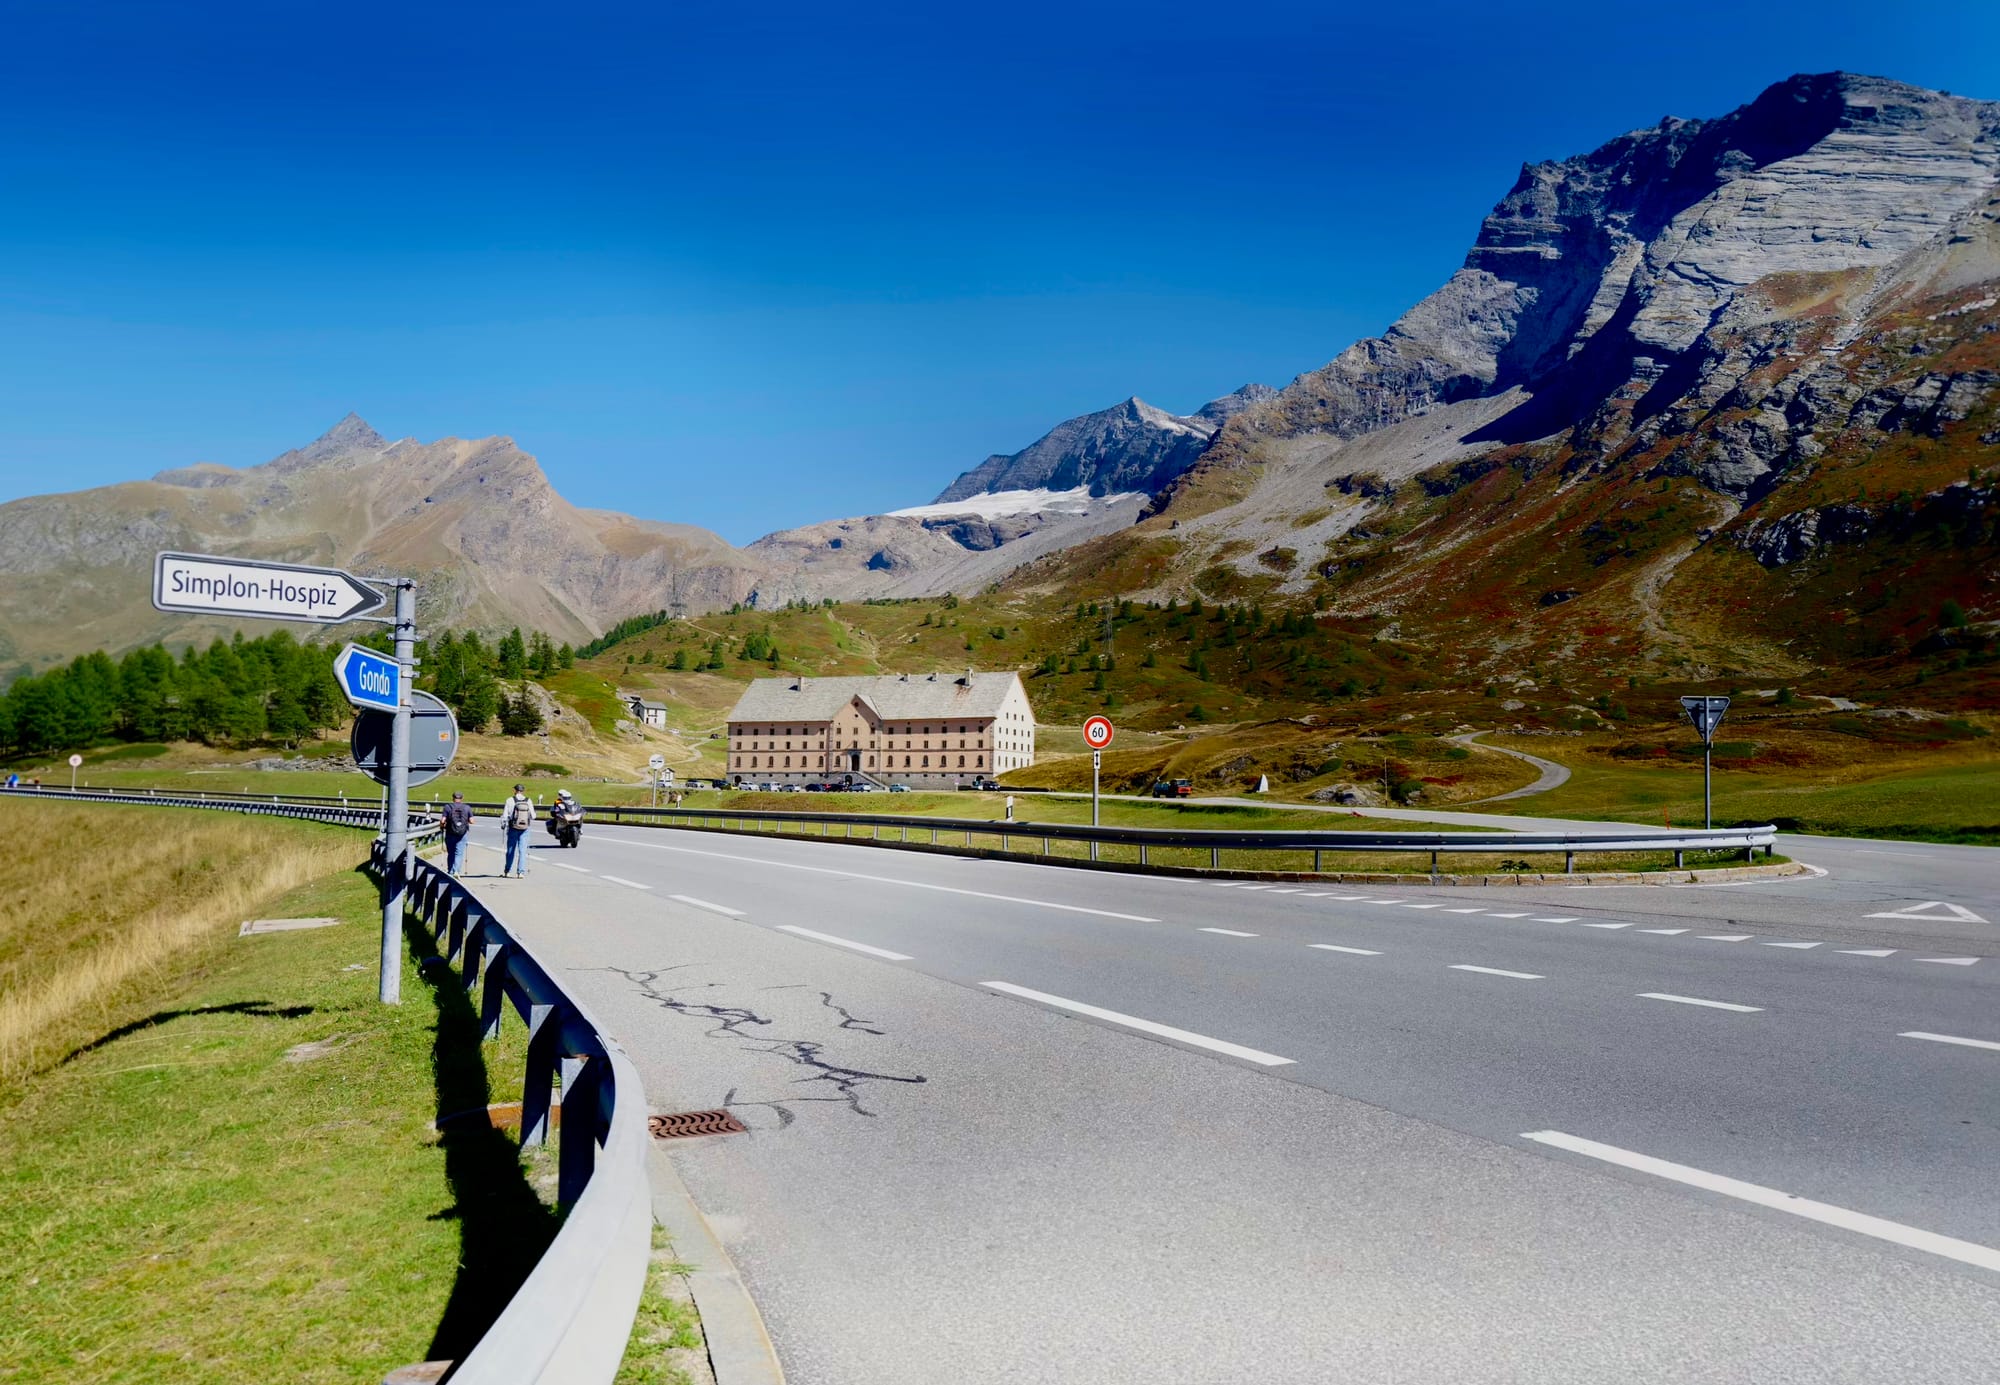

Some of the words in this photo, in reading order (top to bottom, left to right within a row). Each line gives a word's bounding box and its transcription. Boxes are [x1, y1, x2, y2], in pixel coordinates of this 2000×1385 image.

[171, 569, 337, 610] Simplon-Hospiz
[359, 661, 390, 697] Gondo
[1091, 727, 1104, 738] 60
